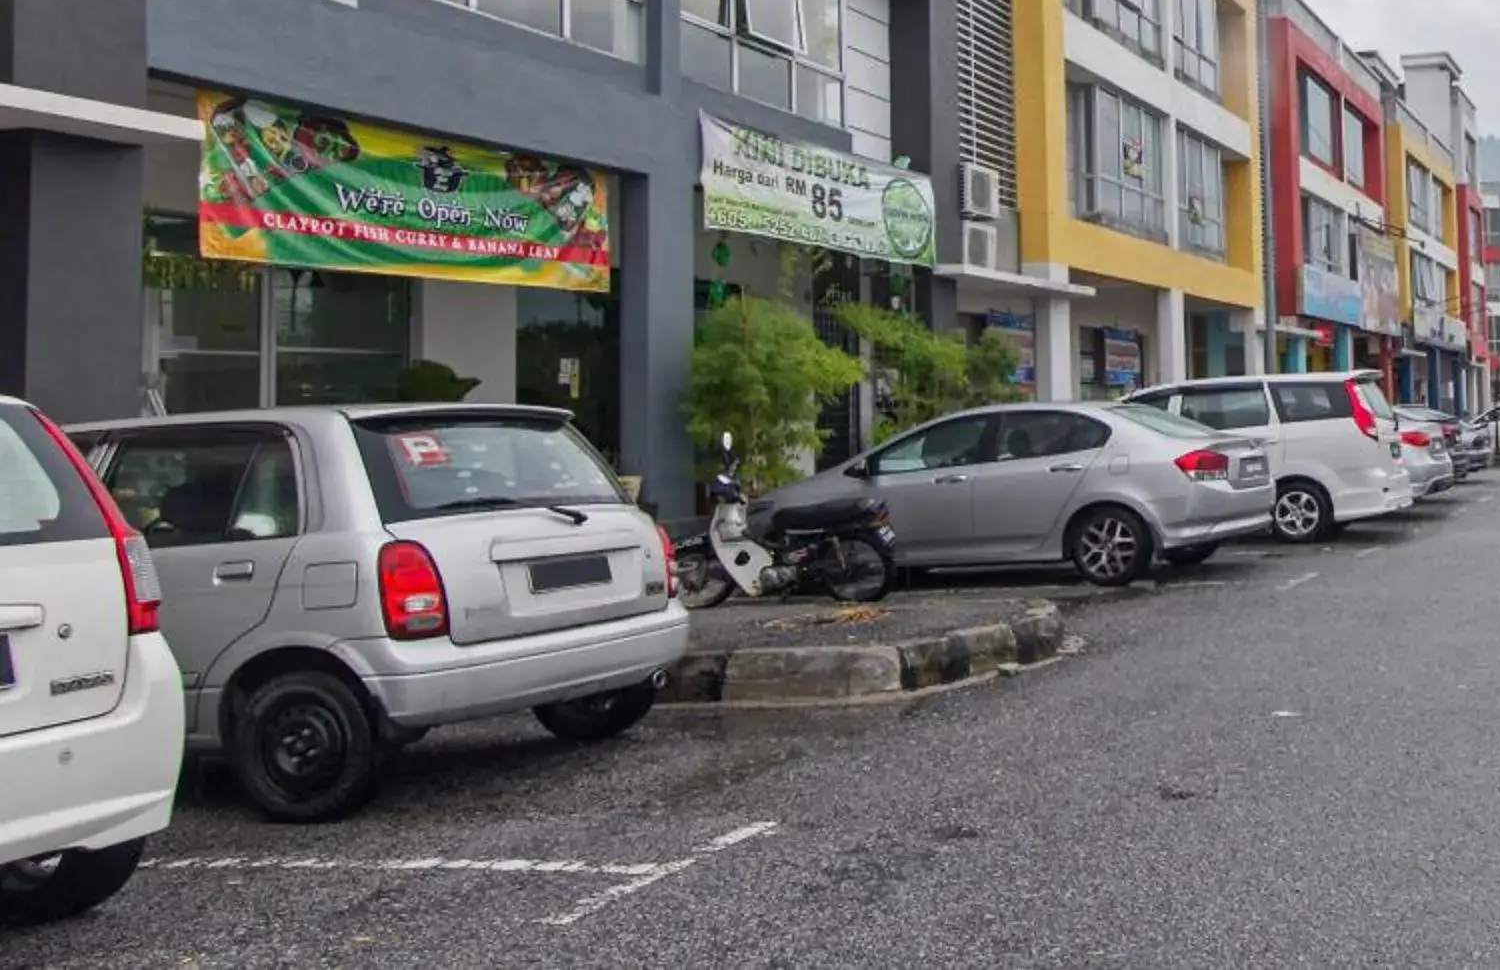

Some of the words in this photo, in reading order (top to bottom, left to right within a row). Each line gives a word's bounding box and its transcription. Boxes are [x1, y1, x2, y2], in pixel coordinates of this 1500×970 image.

[713, 158, 753, 185] Harga
[785, 176, 807, 197] RM
[811, 183, 843, 223] 85
[417, 197, 471, 229] Open
[483, 204, 529, 232] Now
[263, 213, 348, 236] CLAYPOT
[353, 223, 390, 242] FISH
[395, 230, 447, 247] CURRY
[452, 237, 463, 249] &
[468, 239, 525, 257] BANANA
[400, 435, 440, 465] P
